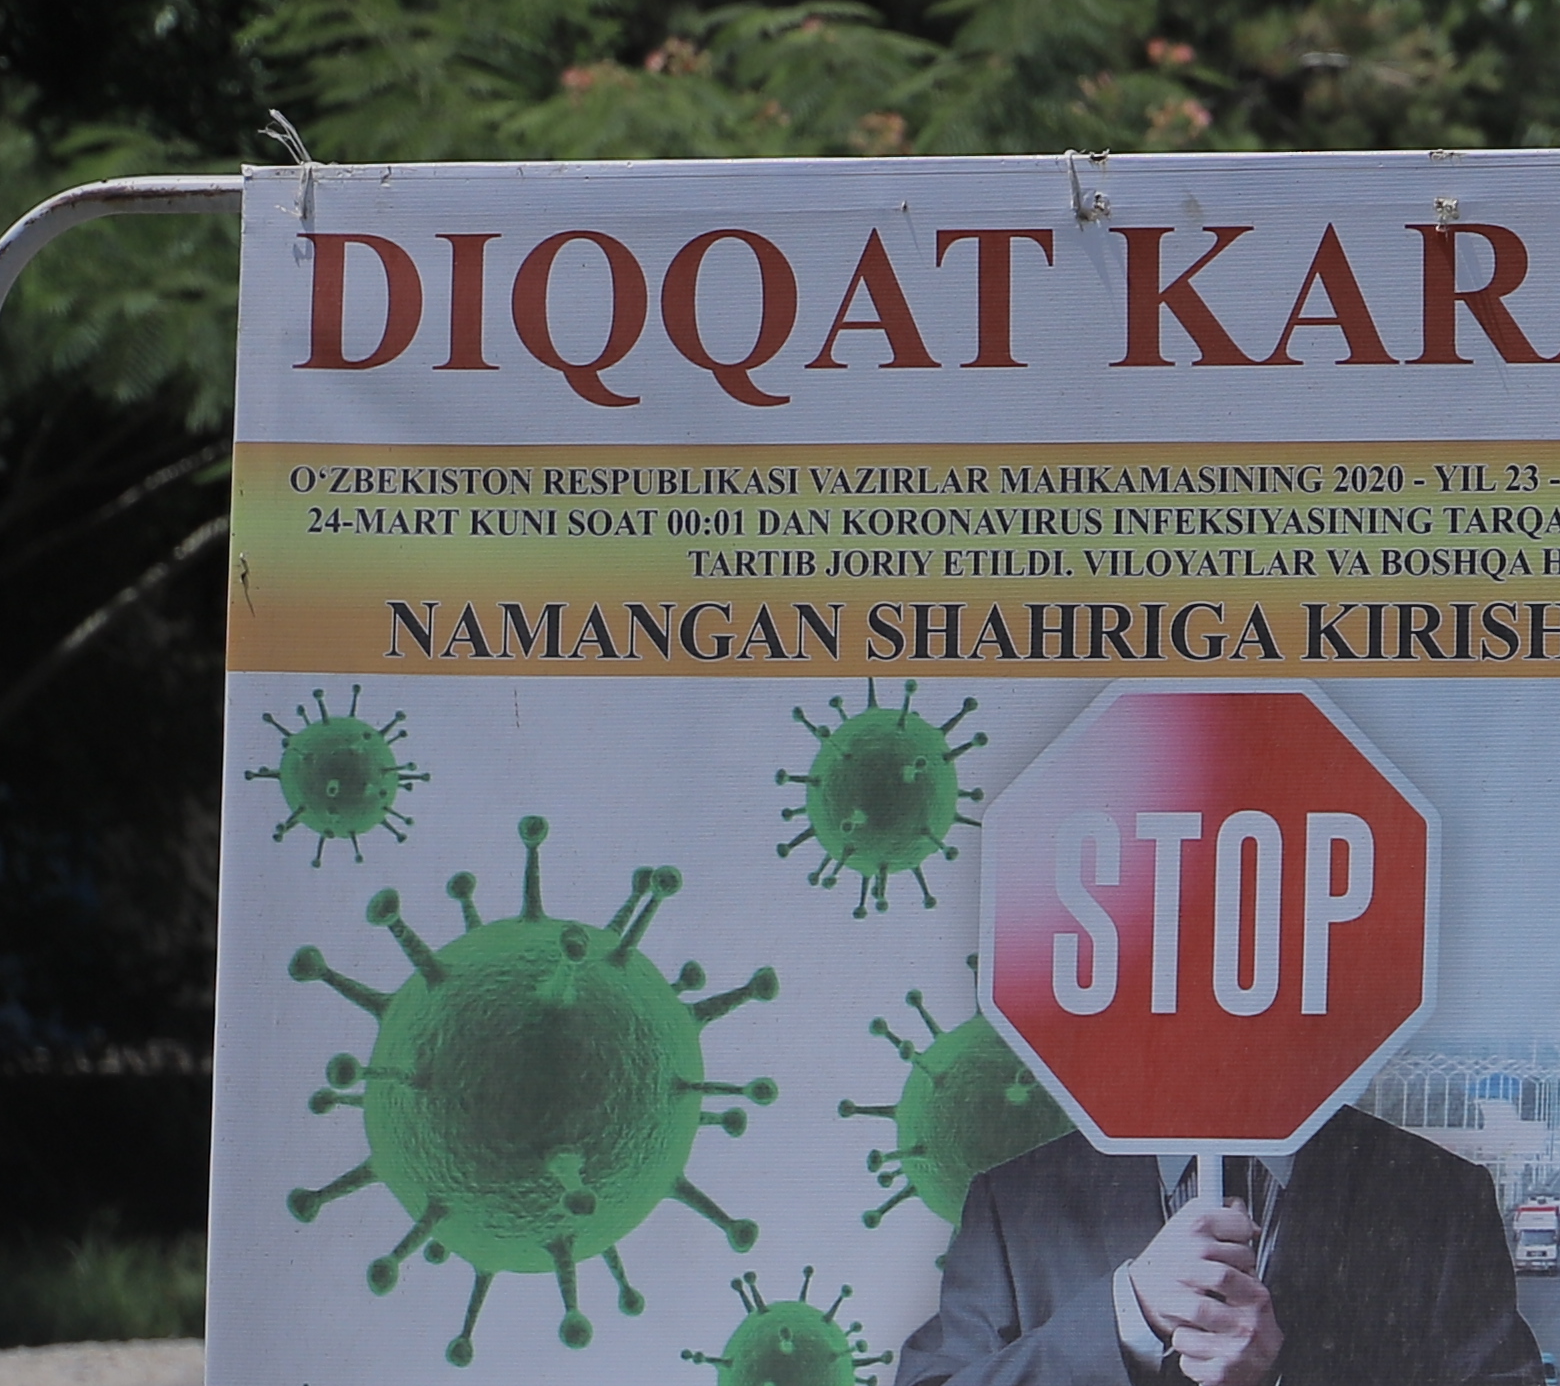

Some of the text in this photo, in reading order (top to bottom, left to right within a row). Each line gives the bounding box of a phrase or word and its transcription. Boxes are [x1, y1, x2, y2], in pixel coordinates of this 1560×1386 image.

[292, 228, 1054, 407] DIQQAT
[544, 468, 797, 495] RESPUBLIKASI
[809, 467, 989, 494] VAZIRLAR
[1001, 466, 1322, 494] MAHKAMASINING
[1333, 465, 1404, 493] 2020
[1435, 465, 1496, 492] YIL
[1505, 465, 1539, 492] 23
[308, 507, 460, 535] 24-MART
[471, 509, 556, 536] KUNI
[568, 509, 658, 536] SOAT
[667, 509, 743, 536] 00:01
[759, 509, 829, 536] DAN
[843, 508, 1102, 536] KORONAVIRUS
[1114, 507, 1432, 535] INFEKSIYASINING
[688, 550, 816, 577] TARTIB
[825, 550, 933, 577] JORIY
[944, 550, 1073, 576] ETILDI.
[1083, 549, 1316, 577] VILOYATLAR
[1326, 549, 1371, 576] VA
[1381, 548, 1532, 582] BOSHQA
[386, 602, 845, 660] NAMANGAN
[867, 603, 1283, 661] SHAHRIGA
[1051, 809, 1375, 1017] STOP
